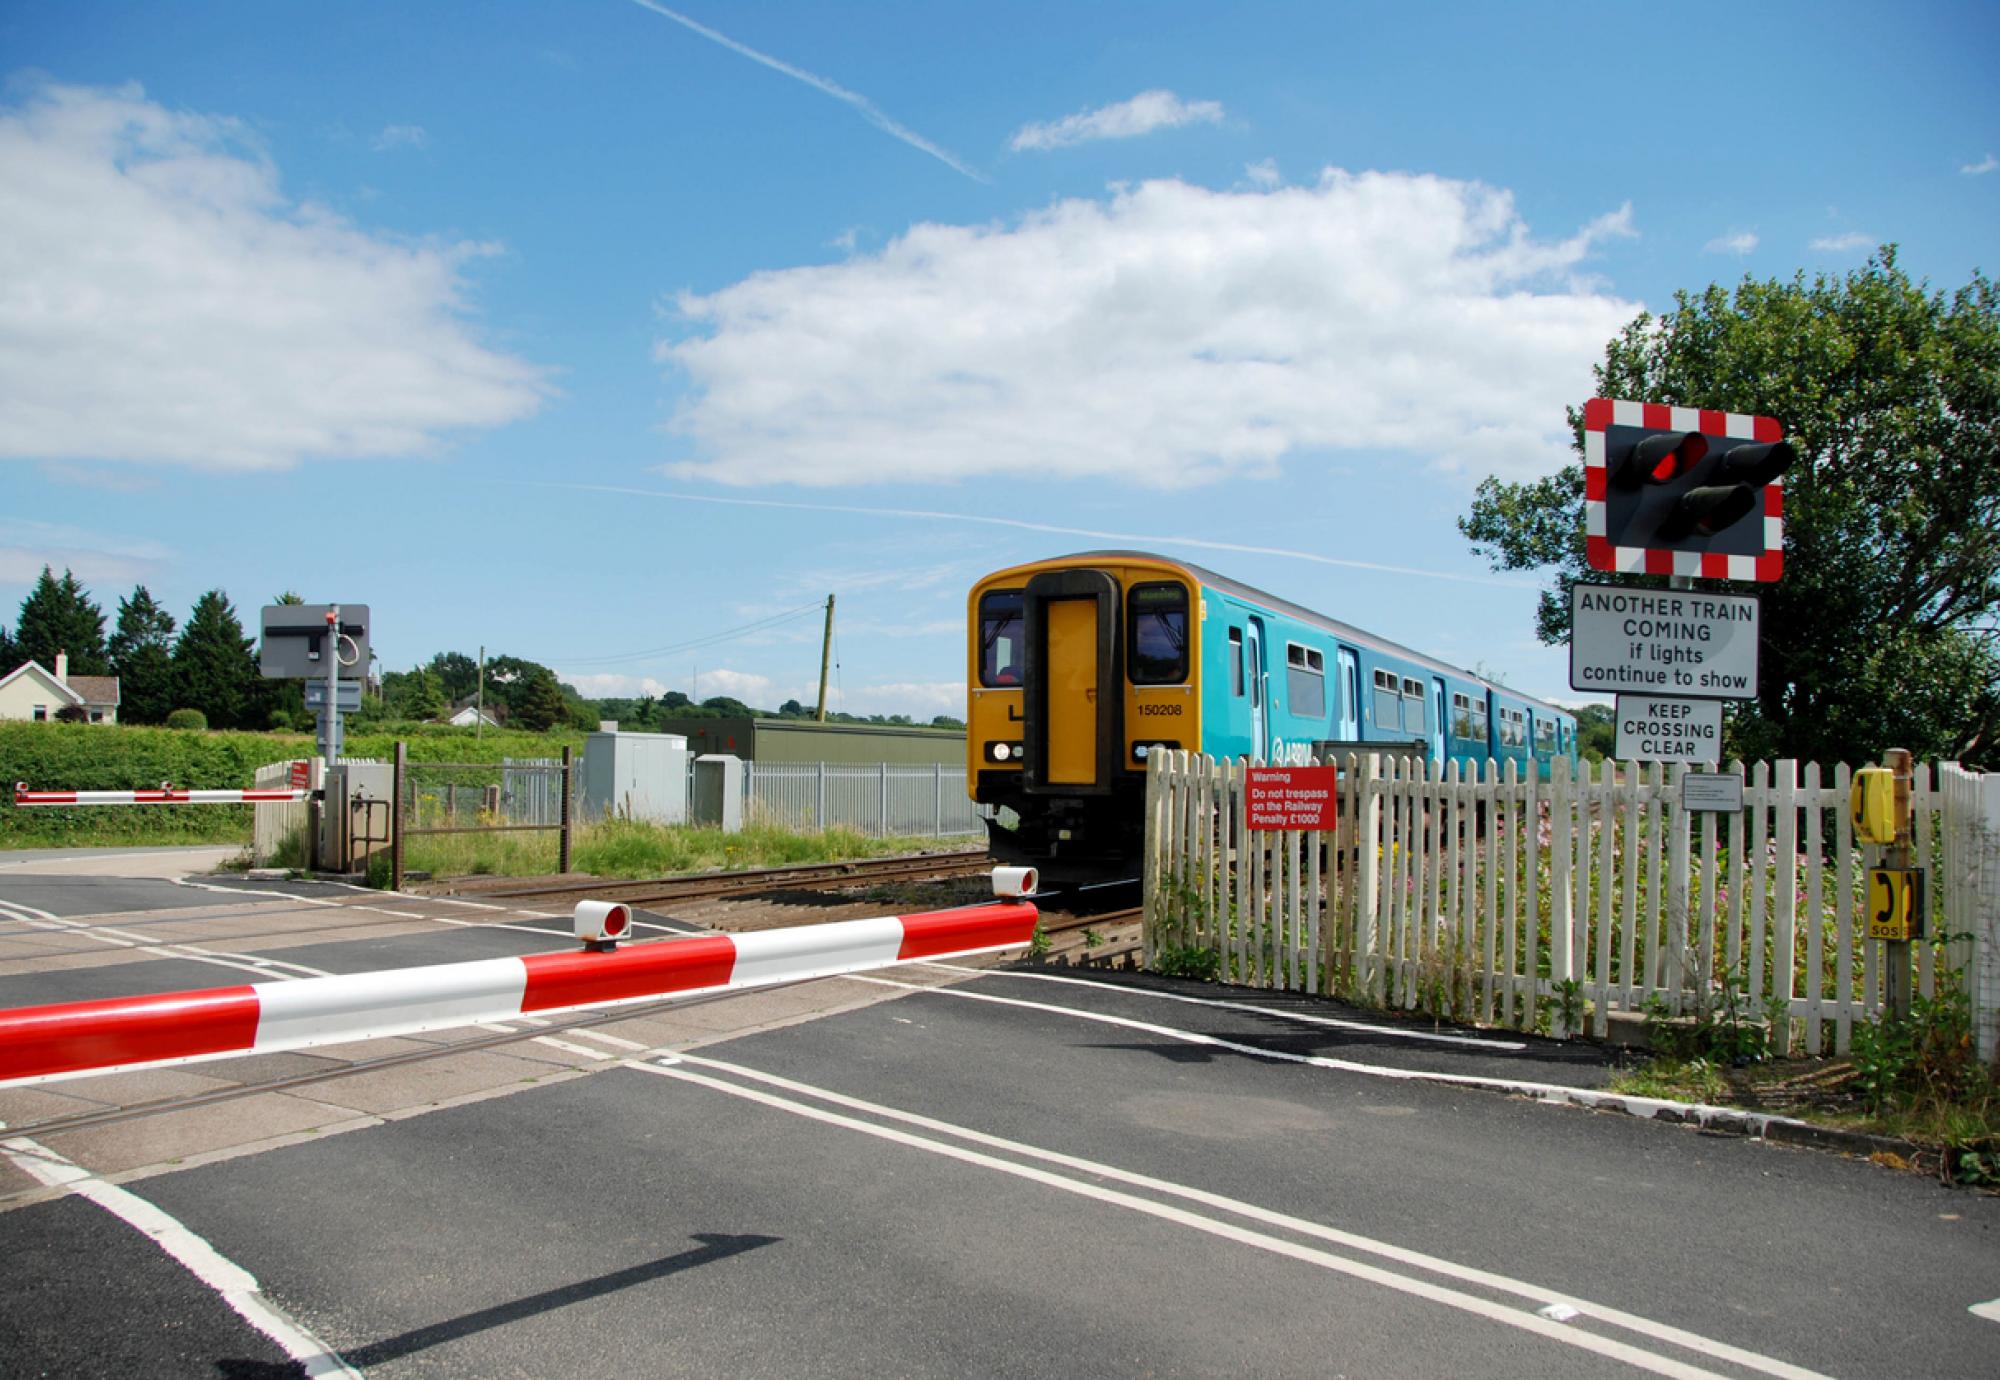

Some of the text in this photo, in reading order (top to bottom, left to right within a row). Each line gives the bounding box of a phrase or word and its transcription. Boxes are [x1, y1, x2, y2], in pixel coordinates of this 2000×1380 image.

[1580, 592, 1753, 622] ANOTHER TRAIN
[1623, 618, 1711, 642] COMING
[1629, 641, 1704, 665] if lights
[1582, 664, 1748, 689] continue to show
[1138, 704, 1182, 716] 150208
[1648, 703, 1692, 719] KEEP
[1623, 720, 1714, 739] CROSSING
[1641, 739, 1696, 756] CLEAR
[1252, 771, 1291, 784] Warning
[1251, 788, 1329, 801] Do not trespass
[1251, 801, 1323, 813] on the Railway
[1251, 814, 1288, 826] Penalty
[1871, 925, 1899, 936] SOS
